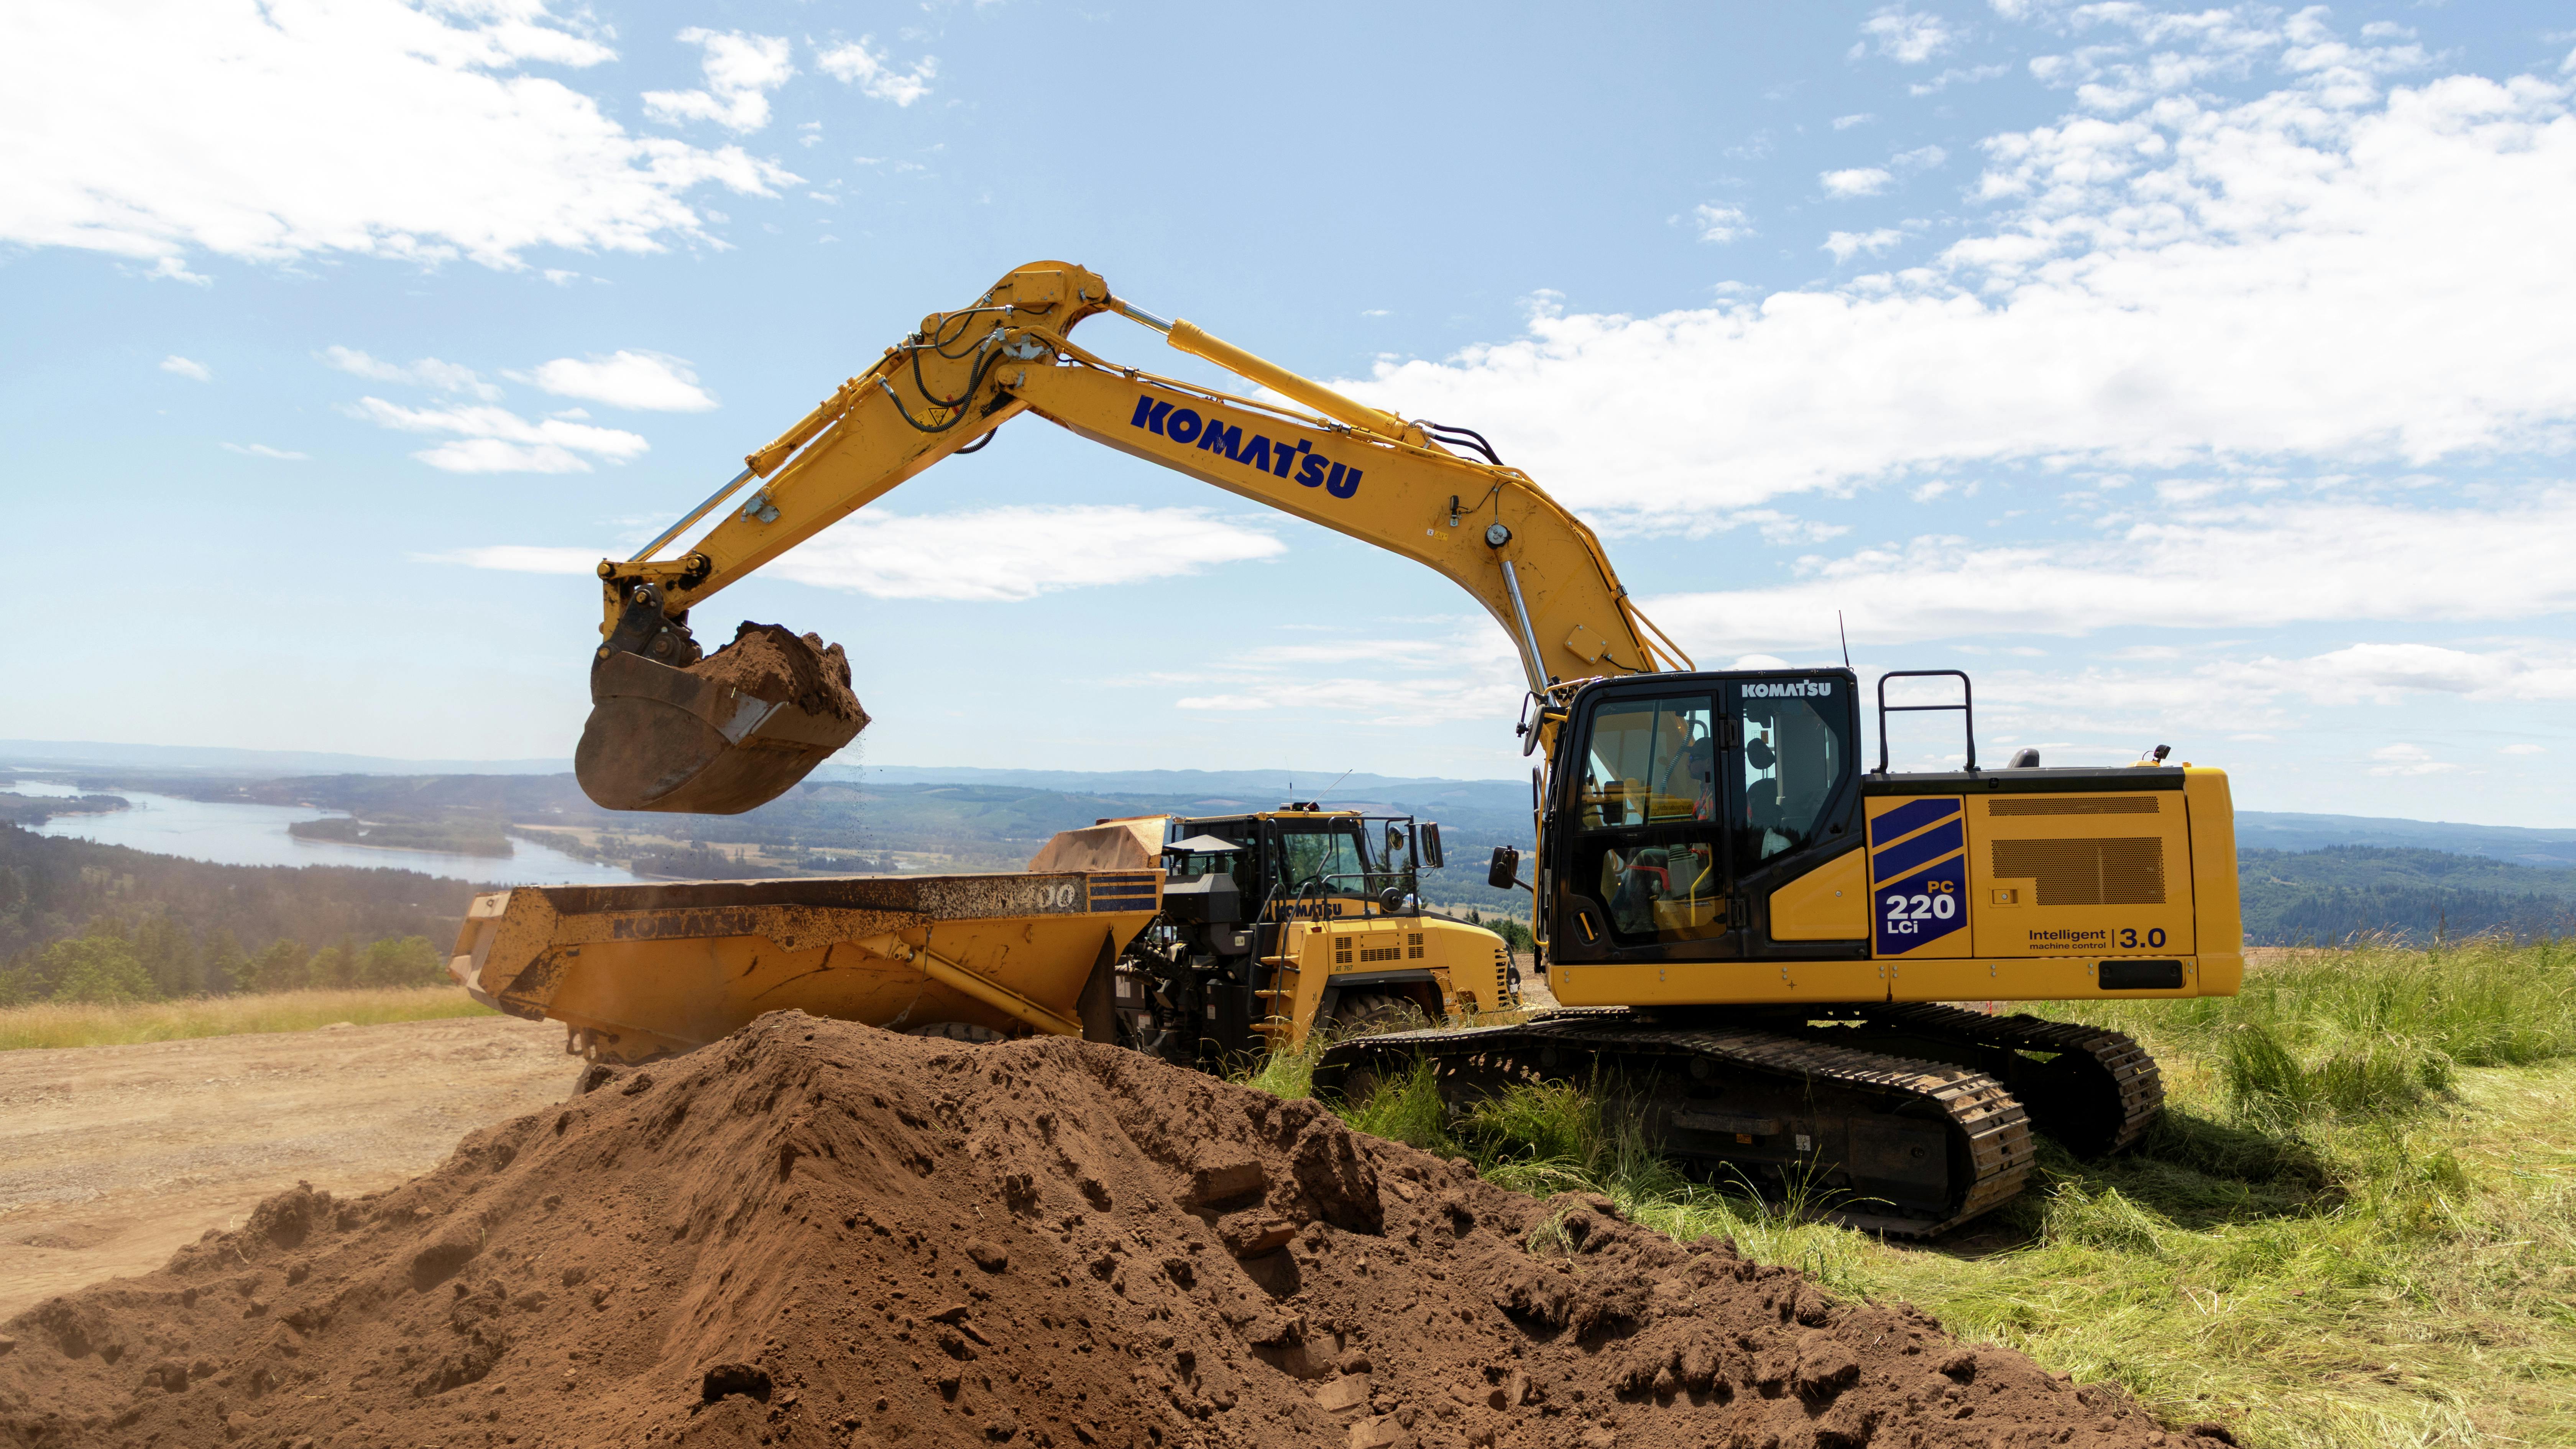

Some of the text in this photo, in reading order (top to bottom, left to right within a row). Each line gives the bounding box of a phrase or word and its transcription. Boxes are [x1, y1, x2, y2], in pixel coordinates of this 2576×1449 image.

[1130, 394, 1363, 499] KOMATSU
[1742, 679, 1831, 697] KOMATSU
[1928, 881, 1954, 893] PC
[1886, 894, 1955, 919] 220
[1888, 921, 1918, 933] LCi
[2029, 928, 2166, 948] Intelligent 3.0
